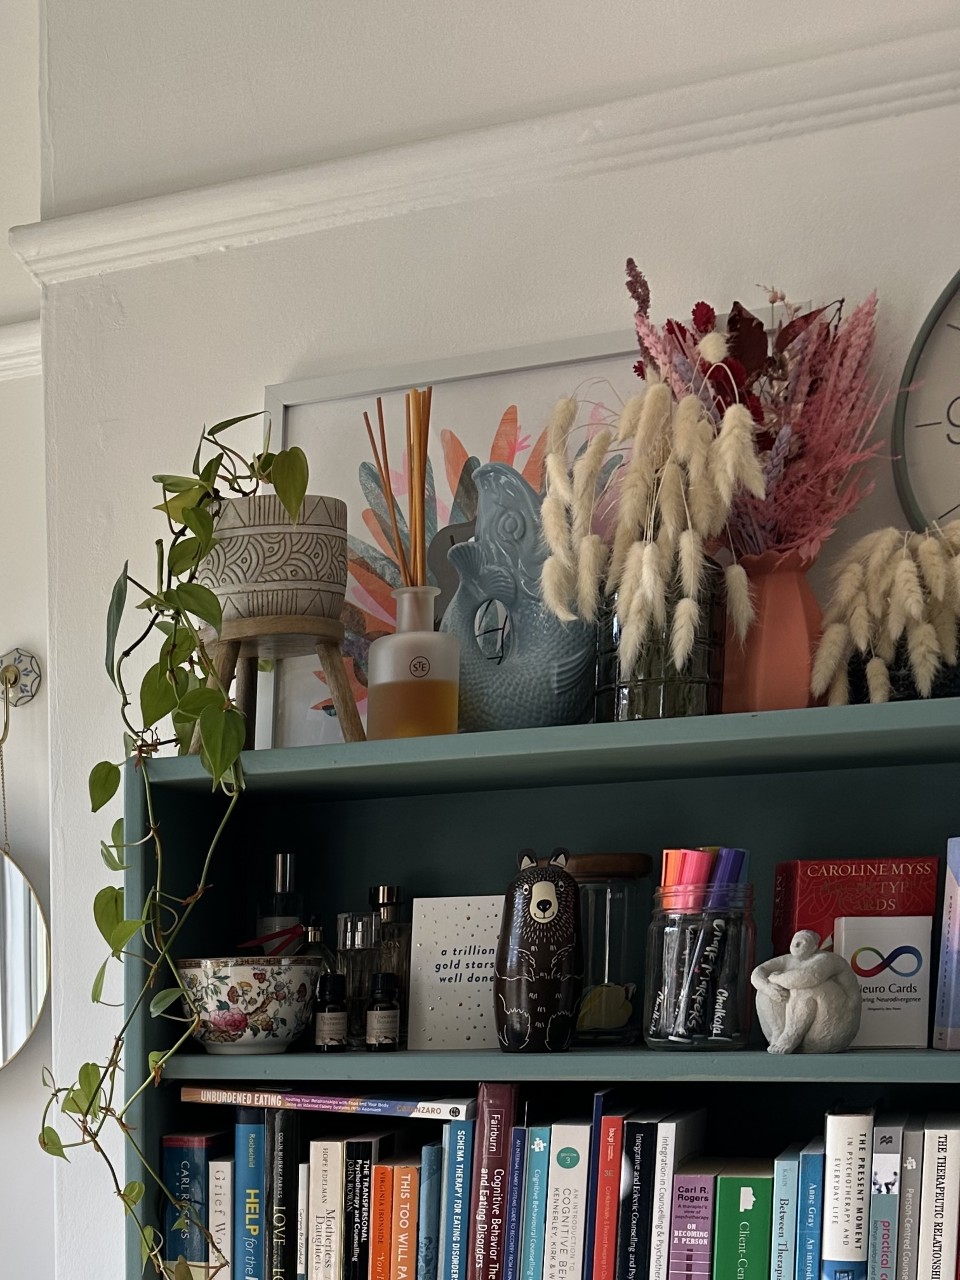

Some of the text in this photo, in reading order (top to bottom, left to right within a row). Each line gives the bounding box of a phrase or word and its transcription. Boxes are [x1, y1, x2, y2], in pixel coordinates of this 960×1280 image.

[807, 862, 932, 877] CAROLINE MYSS
[435, 959, 495, 973] gold stars
[453, 945, 495, 956] trillion
[440, 973, 495, 983] well done
[888, 983, 917, 994] Cards
[200, 1090, 282, 1106] UNBURDENED EATING
[456, 1130, 466, 1162] SCHEMA
[489, 1114, 500, 1152] Fairburn
[608, 1128, 616, 1143] bacp
[847, 1137, 853, 1146] IN
[937, 1134, 948, 1153] THE
[566, 1156, 570, 1164] 3
[633, 1133, 643, 1170] Integrative
[659, 1136, 669, 1177] Integration
[346, 1158, 354, 1181] JOHN
[354, 1159, 362, 1208] Psychotherapy
[400, 1174, 410, 1199] THIS
[454, 1164, 463, 1197] THERAPY
[532, 1169, 540, 1199] Cognitive
[633, 1171, 641, 1185] and
[833, 1158, 841, 1202] EVERYDAY
[934, 1156, 947, 1218] THERAPEUTIC
[361, 1160, 370, 1243] THE TRANSPERSONAL
[378, 1171, 386, 1206] VIRGINIA
[491, 1168, 504, 1215] Cognitive
[632, 1186, 640, 1212] Eclectic
[677, 1194, 709, 1203] Rogers
[678, 1186, 709, 1194] Carl R.
[844, 1151, 853, 1224] PSYCHOTHERAPY
[855, 1133, 866, 1251] THE PRESENT MOMENT
[245, 1189, 260, 1236] HELP
[399, 1203, 409, 1229] TOO
[454, 1199, 462, 1214] FOR
[475, 1168, 489, 1268] and Eating Disorders
[530, 1200, 538, 1237] Behavioural
[550, 1187, 559, 1239] KENNERLEY,
[559, 1188, 571, 1255] COGNITIVE
[655, 1188, 667, 1229] Counselling
[778, 1198, 789, 1238] Between
[806, 1183, 817, 1228] Anne Gray
[903, 1188, 914, 1249] Person-Centred
[273, 1205, 286, 1246] LOVE
[312, 1215, 325, 1271] Daughters
[324, 1208, 336, 1269] Motherless
[351, 1223, 360, 1262] Counselling
[452, 1215, 461, 1241] EATING
[489, 1218, 503, 1260] Behavior
[569, 1189, 578, 1271] AN INTRODUCTION TO
[628, 1212, 639, 1252] Counselling
[673, 1230, 708, 1238] BECOMING
[674, 1236, 708, 1245] A PERSON
[243, 1237, 257, 1254] for
[398, 1232, 408, 1261] WILL
[526, 1238, 536, 1275] Counselling
[806, 1238, 815, 1249] An
[879, 1220, 892, 1269] practical
[245, 1256, 256, 1275] the
